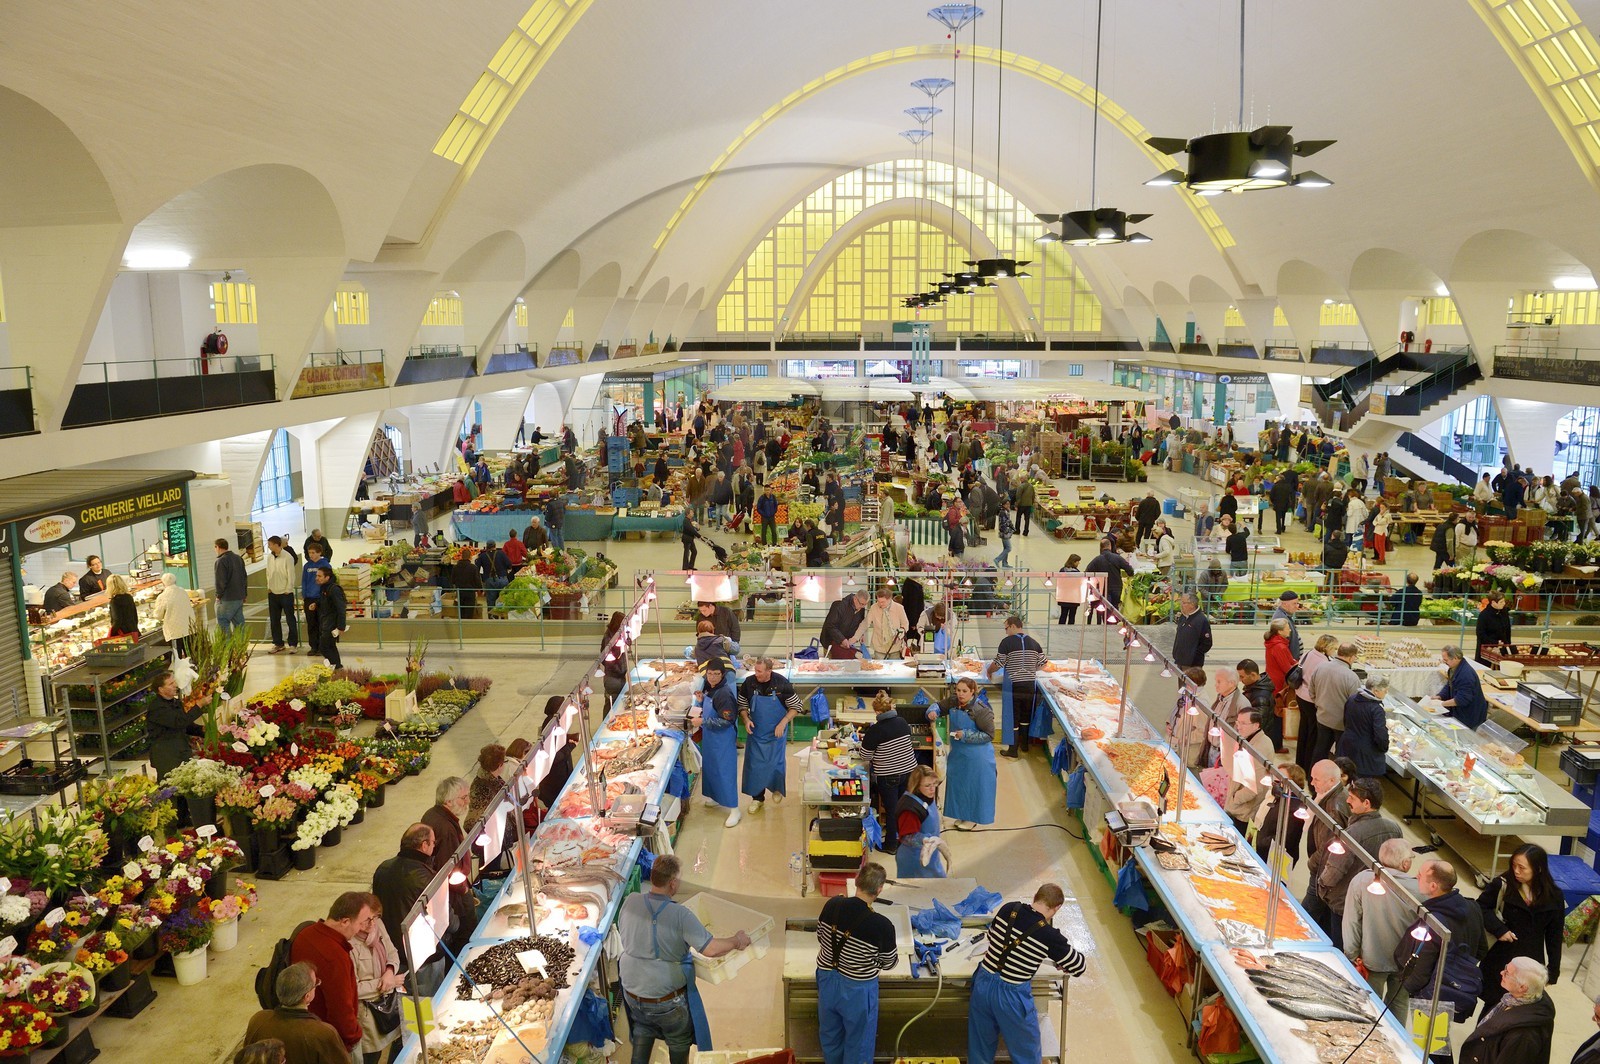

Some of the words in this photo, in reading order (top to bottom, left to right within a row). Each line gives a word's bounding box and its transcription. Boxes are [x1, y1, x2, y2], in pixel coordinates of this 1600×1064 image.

[307, 369, 330, 383] GARAGE
[1499, 369, 1530, 377] CRAVATES
[80, 499, 135, 524] CREMERIE
[136, 487, 182, 509] VIELLARD
